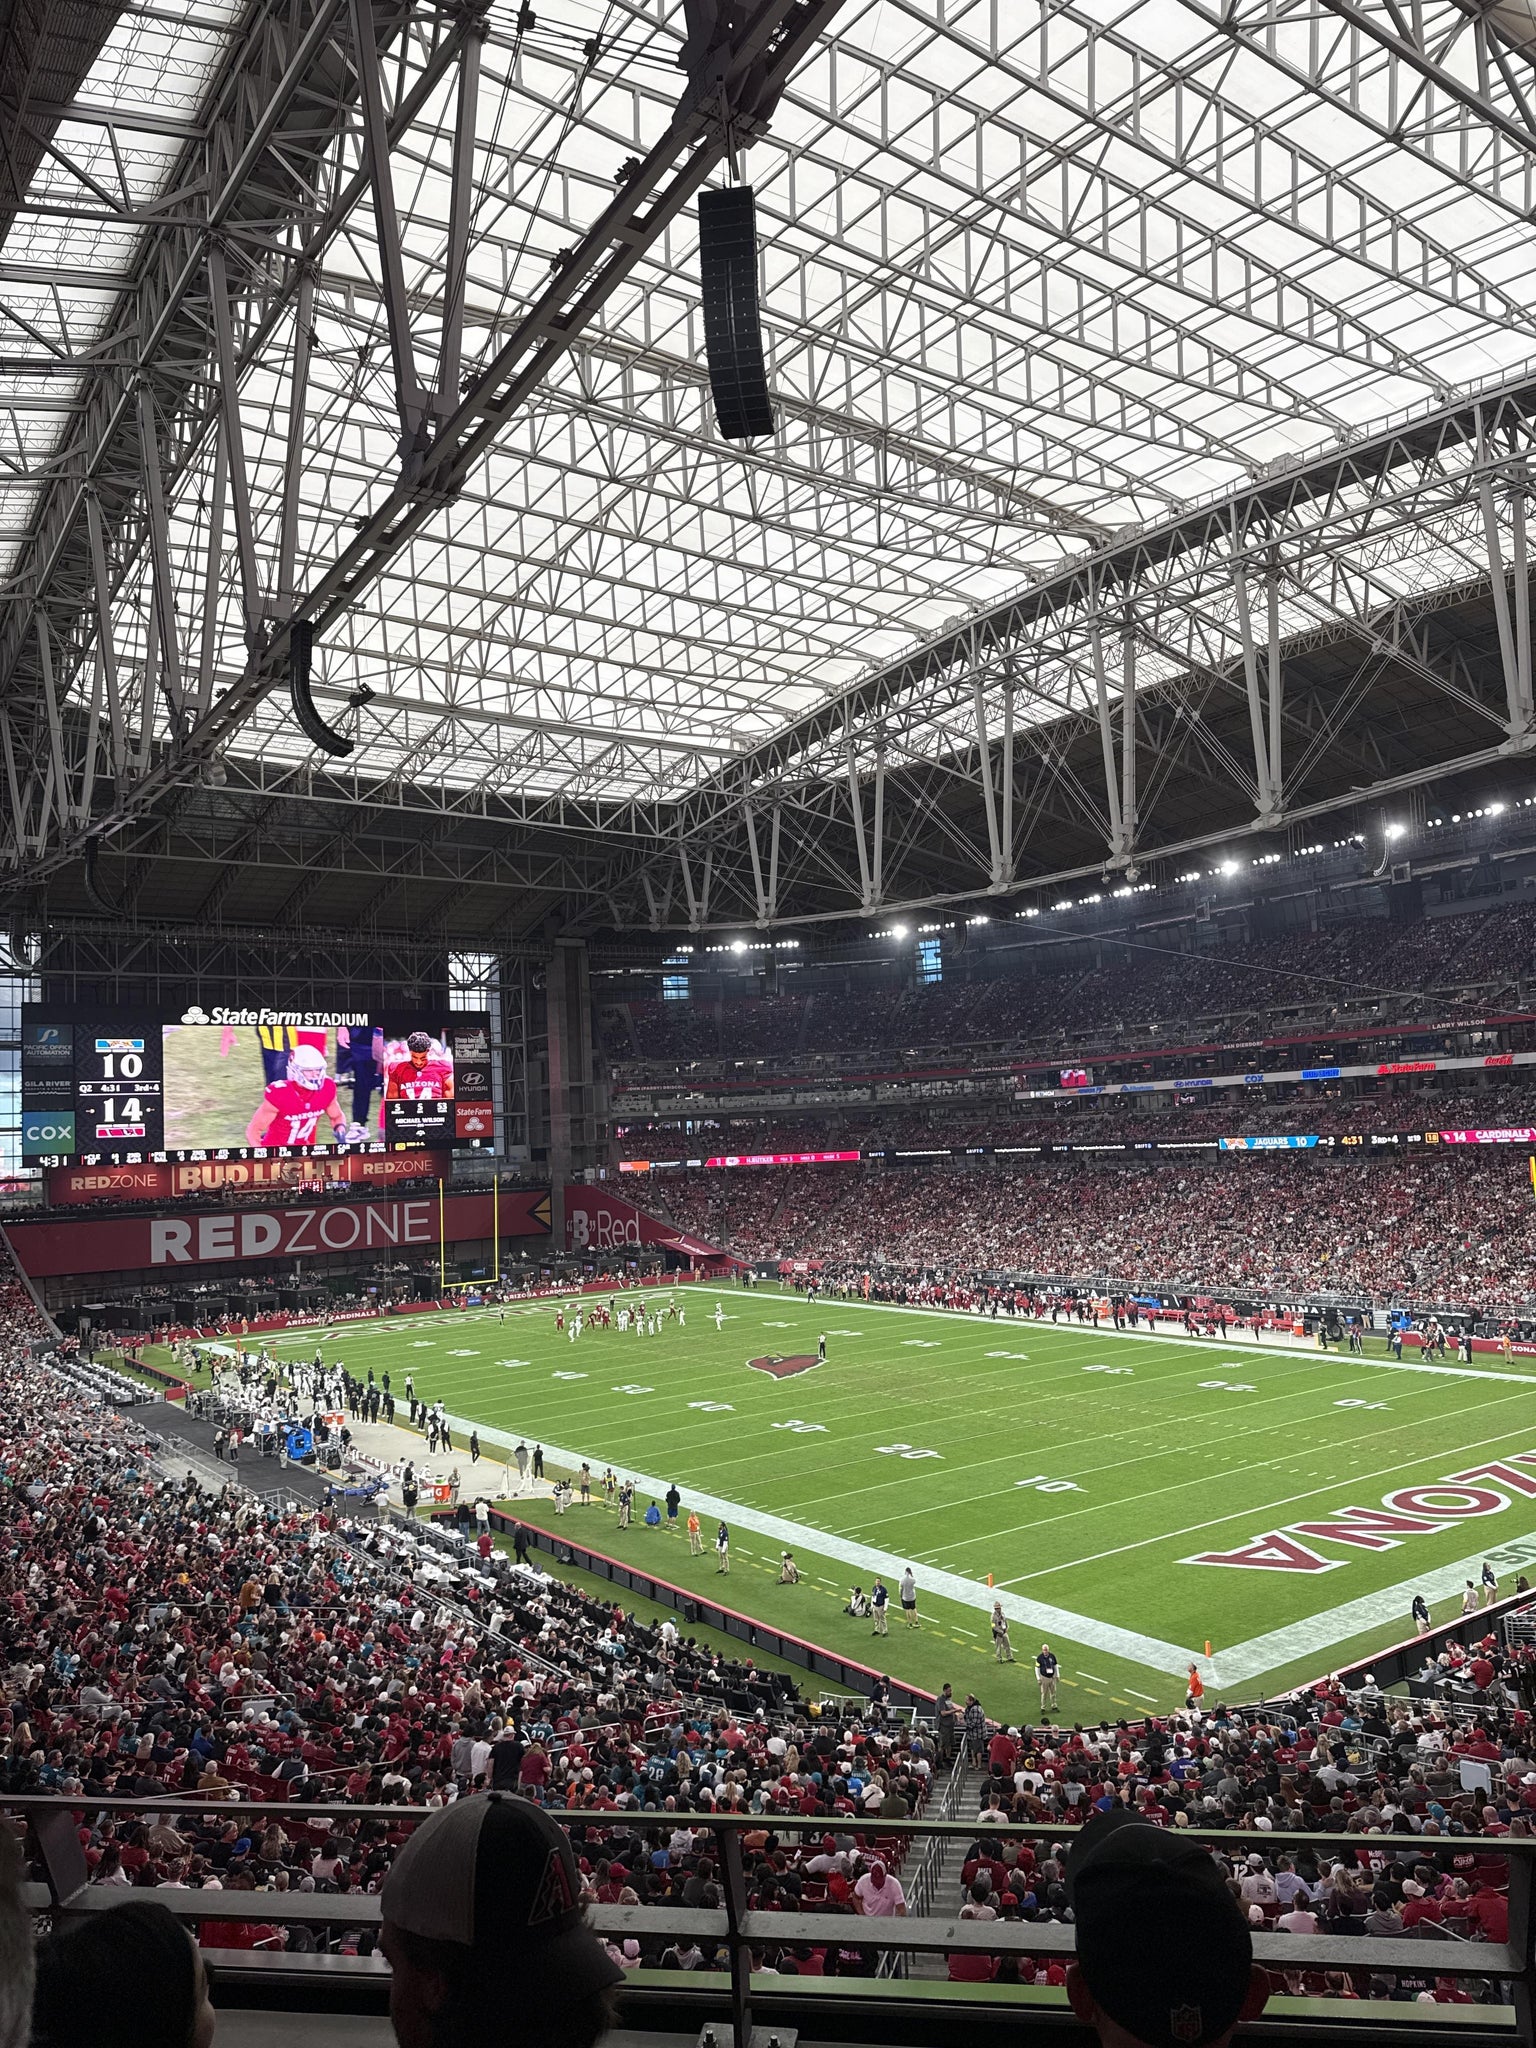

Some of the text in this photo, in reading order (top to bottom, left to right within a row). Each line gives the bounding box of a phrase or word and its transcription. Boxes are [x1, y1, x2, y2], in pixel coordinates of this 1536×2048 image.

[304, 1012, 368, 1026] STADIUM
[1456, 1019, 1486, 1027] WILSON
[103, 1053, 143, 1078] 10
[400, 1081, 440, 1090] ARIZONA
[1184, 1079, 1213, 1088] HYUNDAI
[1244, 1075, 1264, 1083] COX
[79, 1084, 93, 1093] Q2
[100, 1084, 121, 1092] 4:31
[103, 1097, 143, 1122] 14
[26, 1125, 72, 1140] COX
[287, 1117, 318, 1144] 14
[1453, 1129, 1531, 1142] 14 CARDINALS
[1254, 1138, 1289, 1146] JAGUARS
[1295, 1136, 1308, 1148] 10
[1341, 1135, 1363, 1145] 4:31
[39, 1155, 68, 1167] 4:31
[363, 1160, 433, 1175] REDZONE
[179, 1160, 344, 1190] BUD LIGHT
[71, 1174, 158, 1190] REDZONE
[150, 1201, 432, 1264] REDZONE
[597, 1210, 640, 1247] Red
[285, 1317, 321, 1327] ARIZON
[1497, 1344, 1536, 1354] AZONA
[611, 1384, 655, 1395] 50
[688, 1401, 733, 1412] 40
[770, 1419, 823, 1433] 30
[872, 1443, 938, 1459] 20
[1013, 1475, 1077, 1493] 10
[1311, 1712, 1320, 1723] 5
[1233, 1863, 1248, 1882] 12
[1401, 1979, 1427, 1988] HOPKINS
